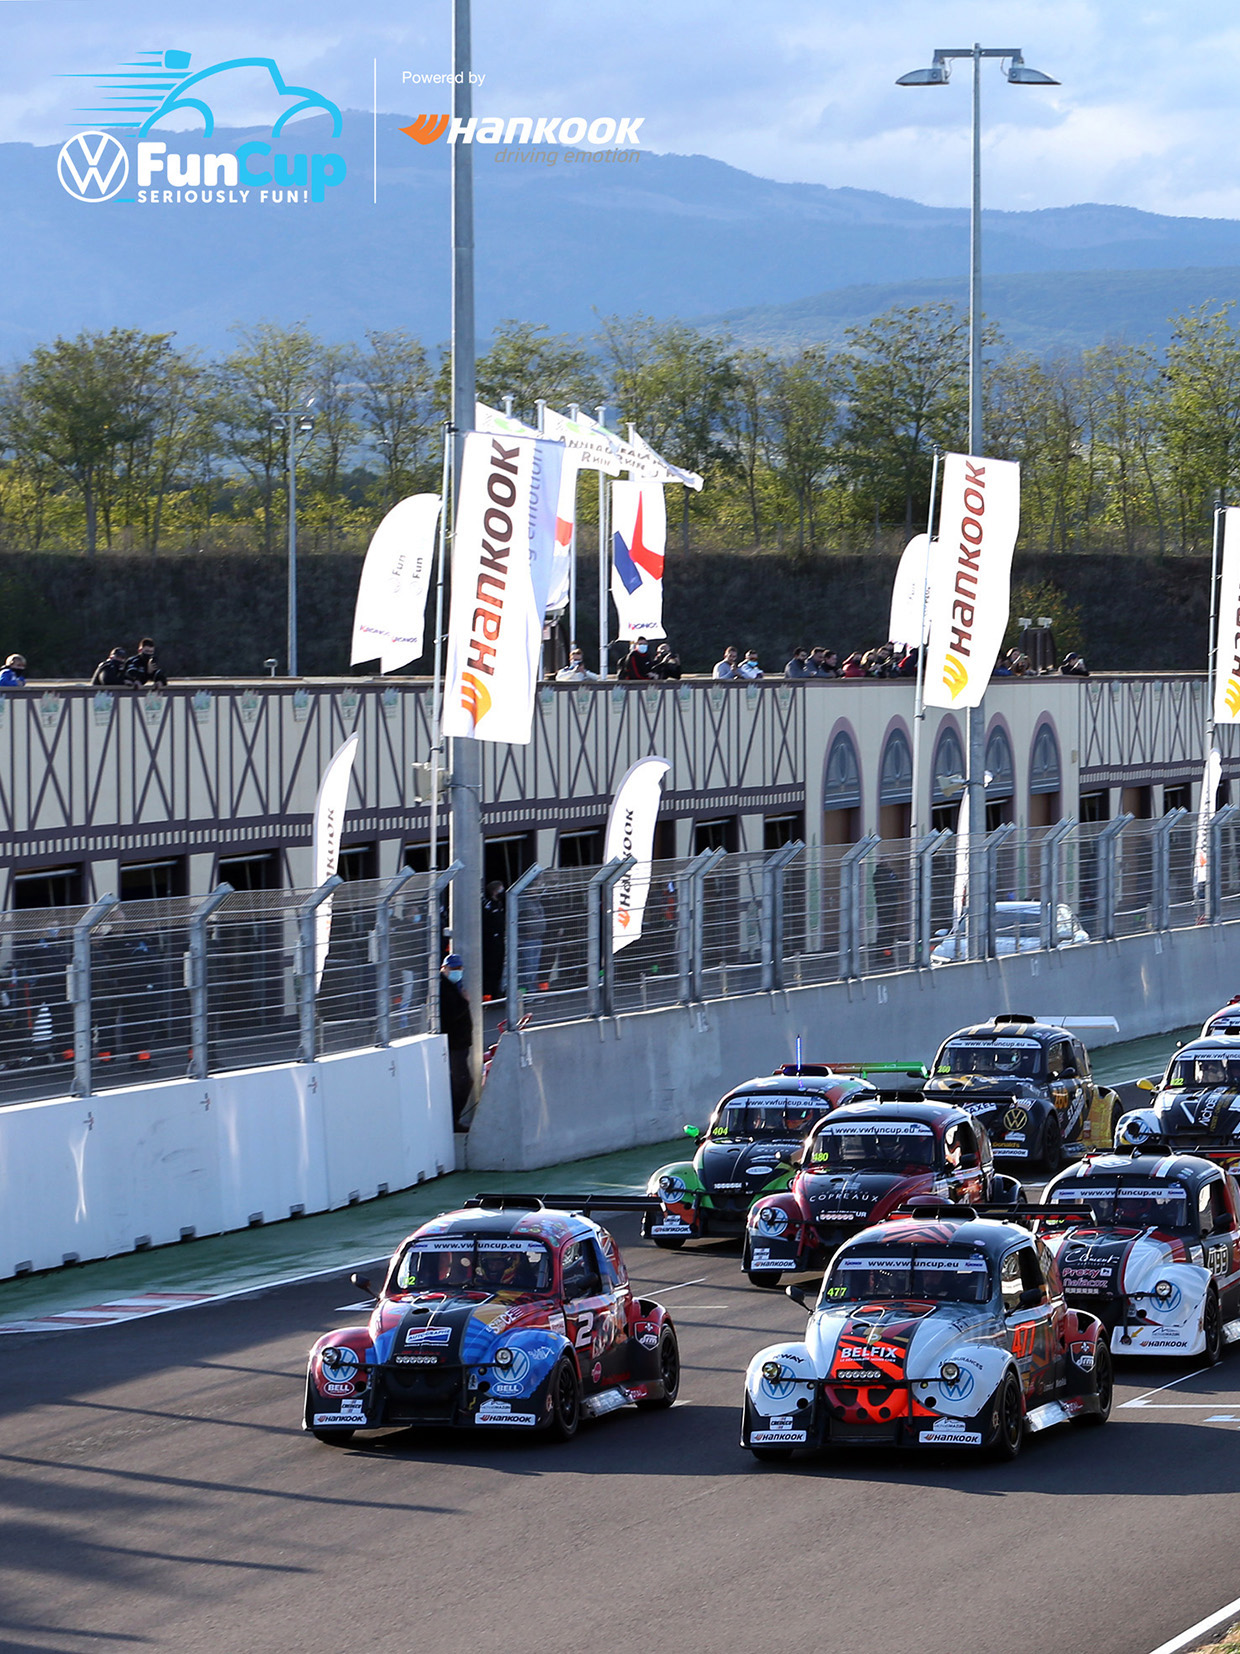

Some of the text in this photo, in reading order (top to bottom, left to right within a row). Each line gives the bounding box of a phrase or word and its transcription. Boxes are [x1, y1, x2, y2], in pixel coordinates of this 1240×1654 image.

[712, 1126, 729, 1137] 404
[434, 1242, 522, 1250] www.vwuncup.eu
[868, 1259, 960, 1269] www.vwuncup.eu
[826, 1287, 848, 1297] 477
[1011, 1320, 1037, 1359] 477
[840, 1346, 899, 1358] BELFIX
[327, 1384, 350, 1392] BELL
[495, 1384, 520, 1392] BELL
